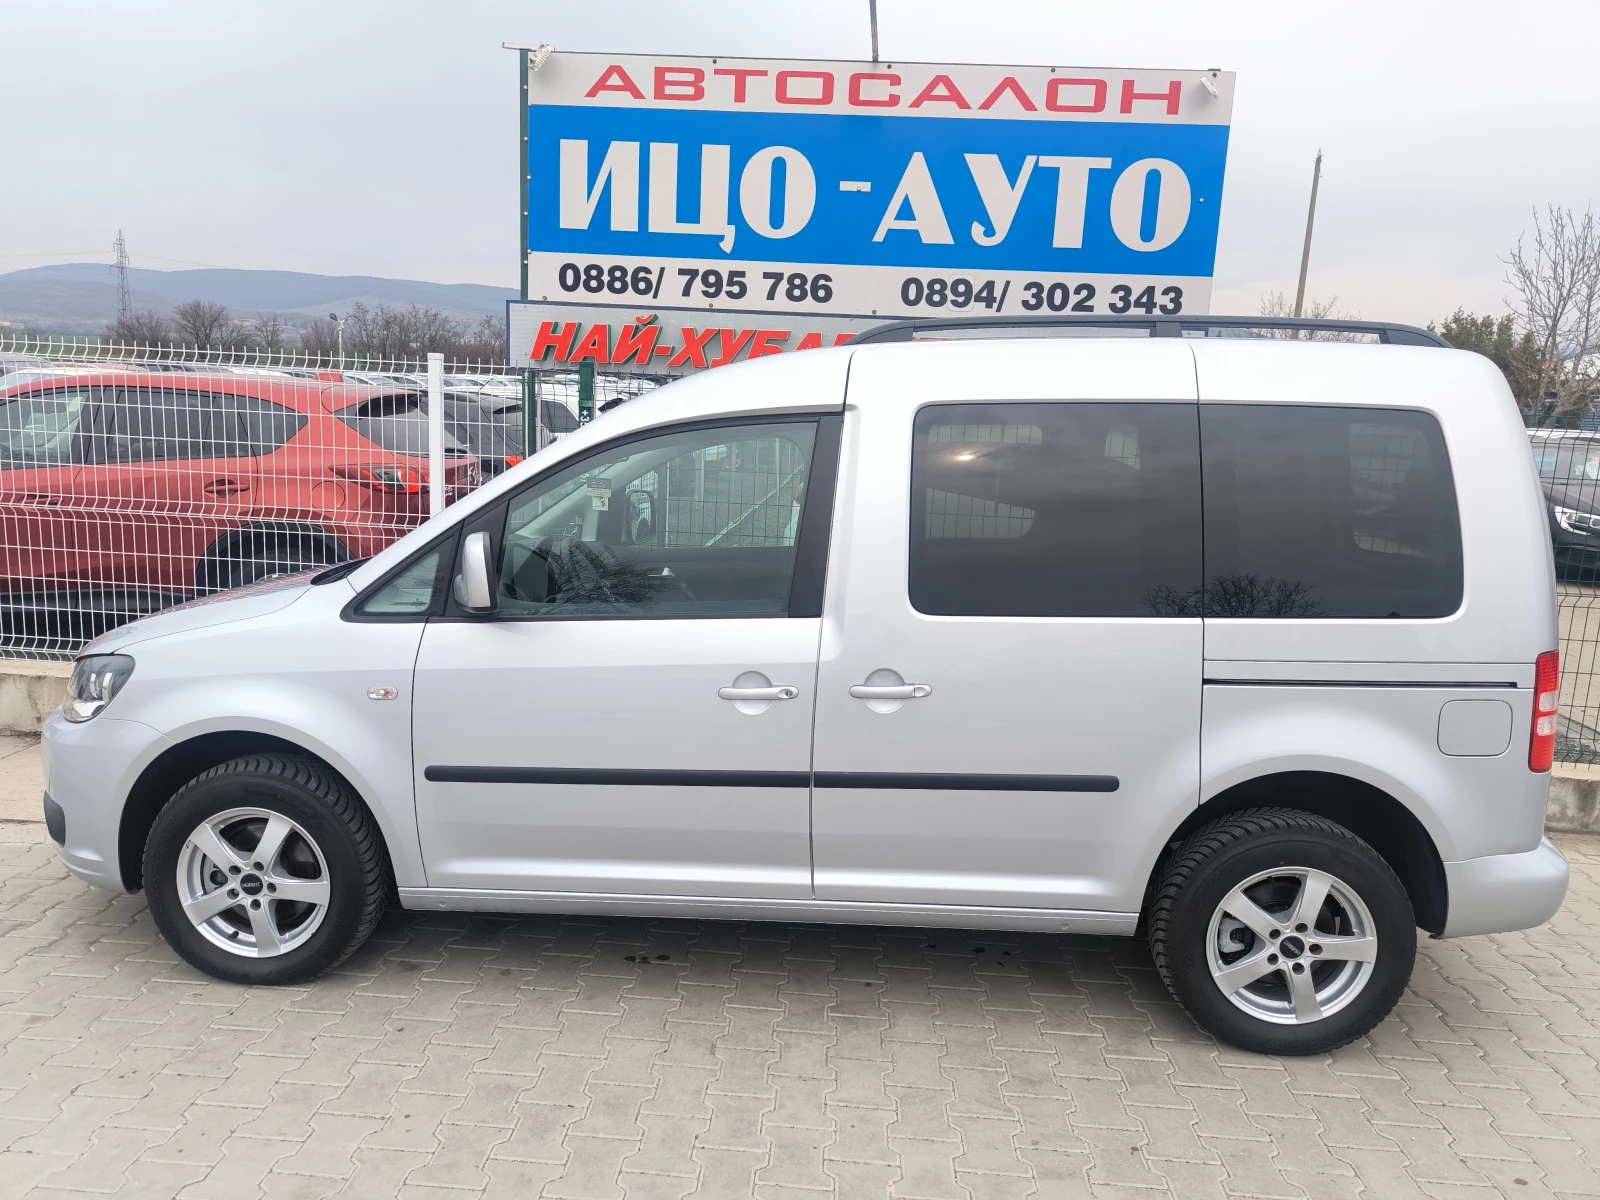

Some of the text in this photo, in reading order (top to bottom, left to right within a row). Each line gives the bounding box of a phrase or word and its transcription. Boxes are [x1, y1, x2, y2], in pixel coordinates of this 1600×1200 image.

[584, 64, 1182, 116] АВТОСАЛОН
[558, 262, 833, 304] 0886/ 795 786
[900, 277, 1184, 316] 0894/ 302 343
